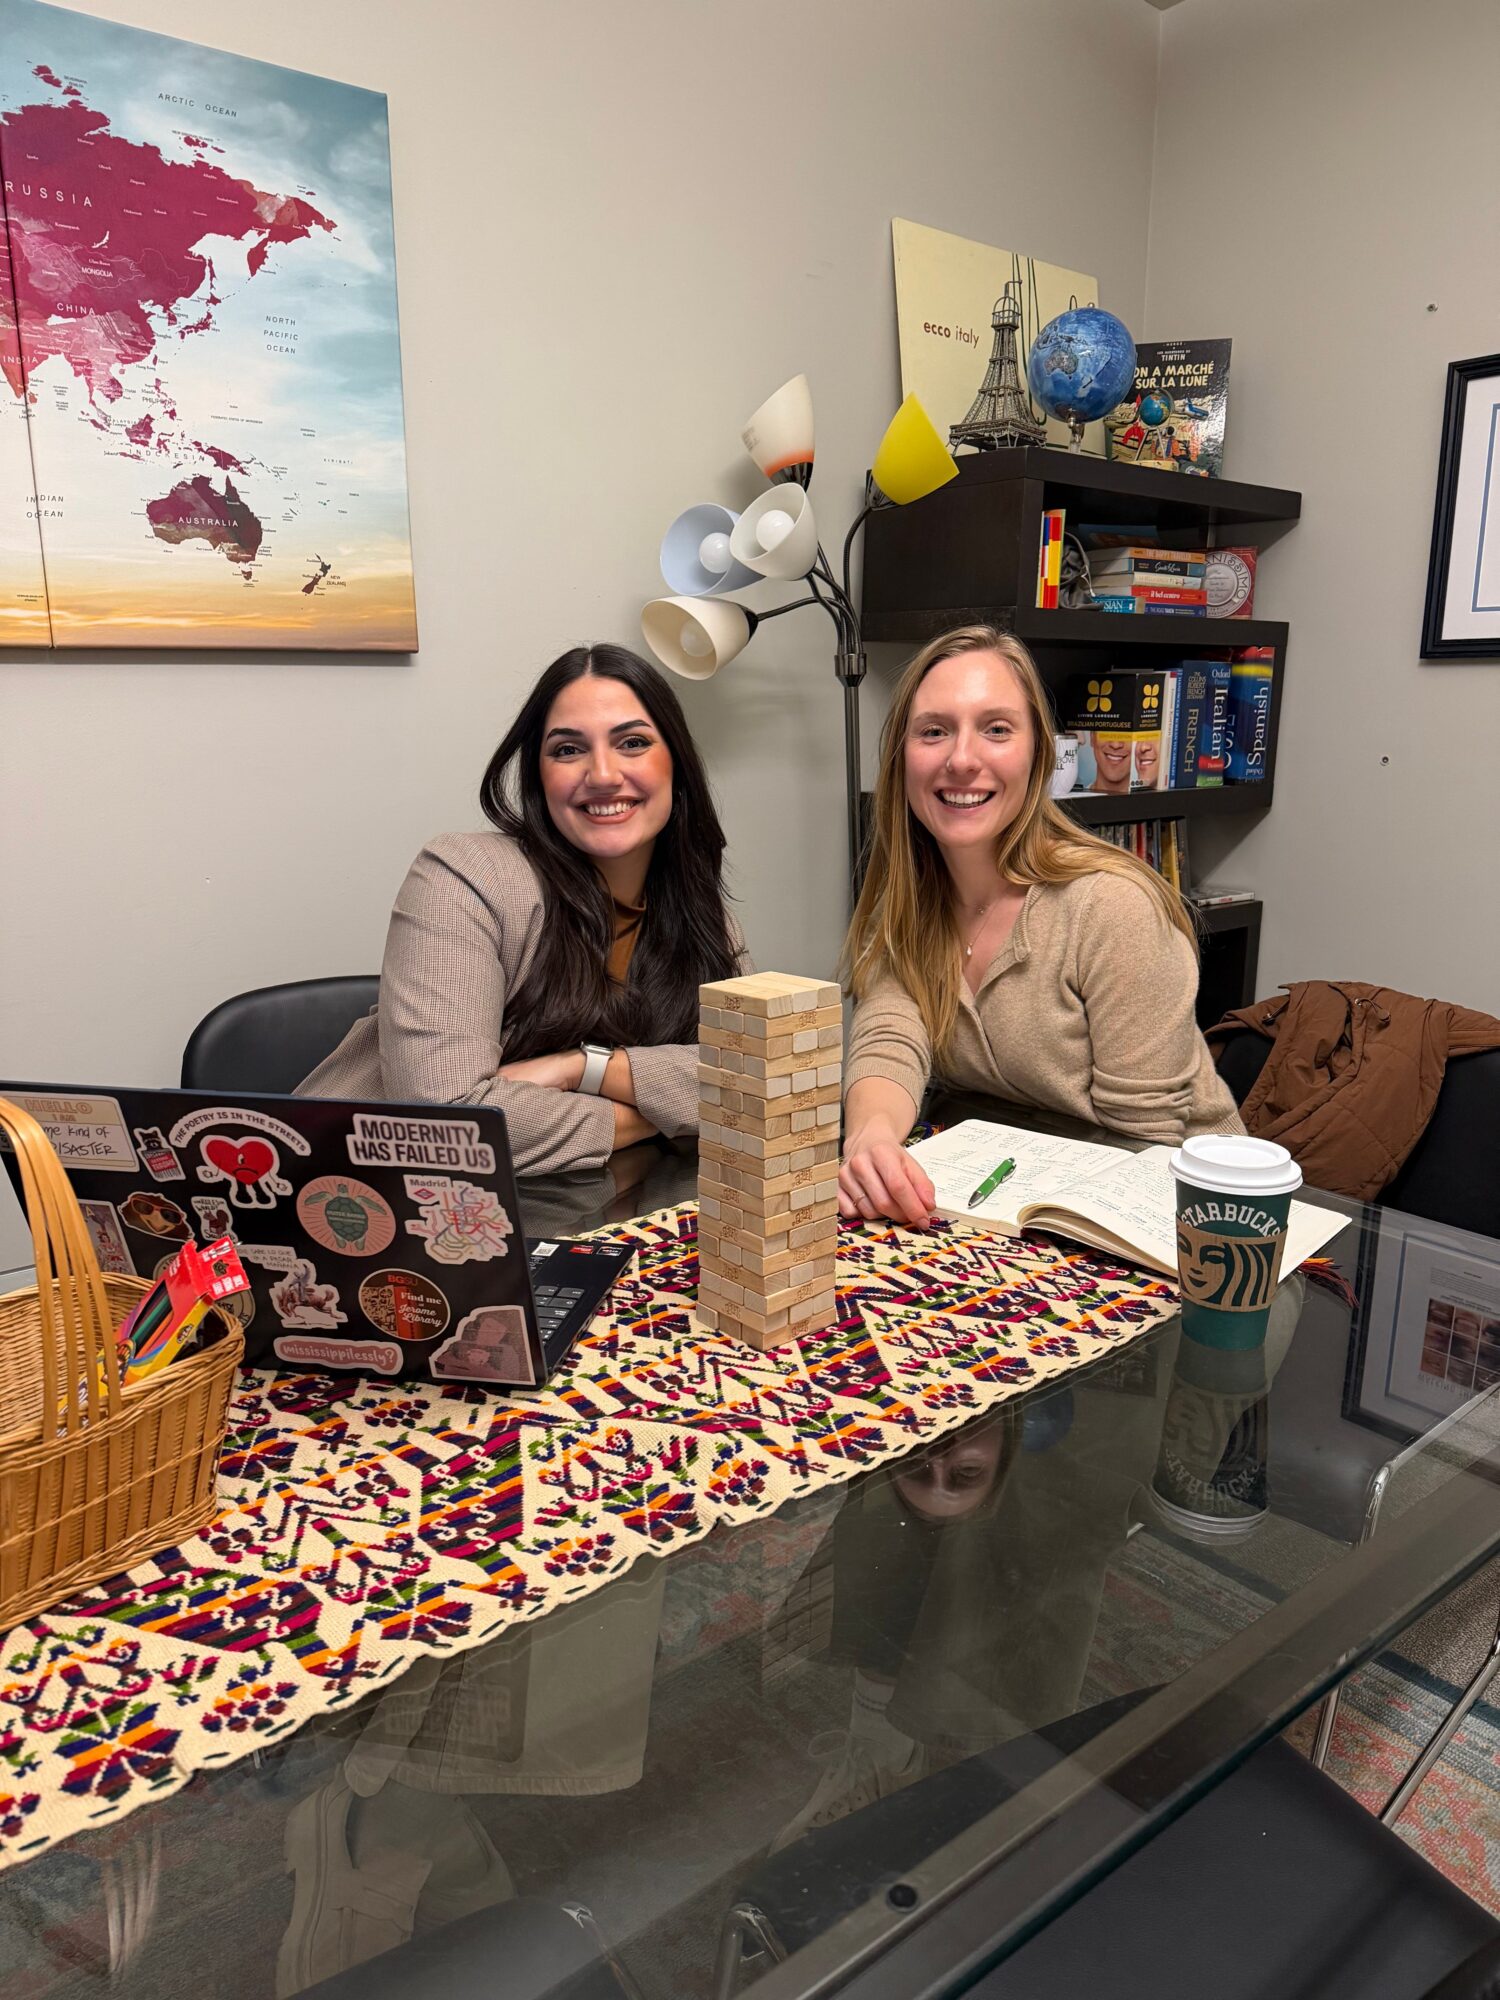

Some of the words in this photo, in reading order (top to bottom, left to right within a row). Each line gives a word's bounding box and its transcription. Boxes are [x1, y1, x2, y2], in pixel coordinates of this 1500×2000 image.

[158, 92, 195, 107] ARCTIC
[205, 104, 237, 117] OCEAN
[5, 181, 92, 207] RUSSIA
[81, 267, 113, 277] MONGOLIA
[57, 303, 95, 315] CHINA
[266, 315, 296, 326] NORTH
[263, 329, 299, 341] PACIFIC
[923, 322, 951, 338] ecco
[955, 325, 980, 349] italy
[266, 344, 296, 354] OCEAN
[1134, 367, 1149, 378] ON
[1152, 366, 1161, 377] A
[1164, 360, 1214, 376] MARCHÉ
[1135, 378, 1157, 389] SUR
[1161, 376, 1176, 388] LA
[1180, 375, 1209, 387] LUNE
[178, 516, 239, 527] AUSTRALIA
[1103, 600, 1123, 609] SIAN
[1211, 668, 1231, 679] Oxford
[1095, 721, 1131, 729] PORTUGUESE
[1211, 688, 1228, 760] Italian
[1246, 687, 1268, 765] Spanish
[1184, 708, 1199, 772] FRENCH
[24, 1099, 93, 1114] HELLO
[43, 1126, 61, 1138] me
[68, 1125, 90, 1138] kind
[174, 1128, 186, 1143] THE
[184, 1112, 214, 1131] POETRY
[216, 1111, 229, 1119] IS
[231, 1112, 243, 1120] IN
[246, 1114, 266, 1126] THE
[268, 1121, 307, 1152] STREETS
[360, 1119, 474, 1146] MODERNITY
[353, 1140, 391, 1161] HAS
[395, 1143, 461, 1166] FAILED
[465, 1148, 491, 1169] US
[409, 1178, 448, 1188] Madrid
[387, 1274, 418, 1286] BGSU
[400, 1291, 424, 1302] Find
[425, 1297, 442, 1305] me
[398, 1304, 437, 1316] Jerome
[402, 1312, 442, 1327] Library
[282, 1344, 395, 1366] mississippilessly?
